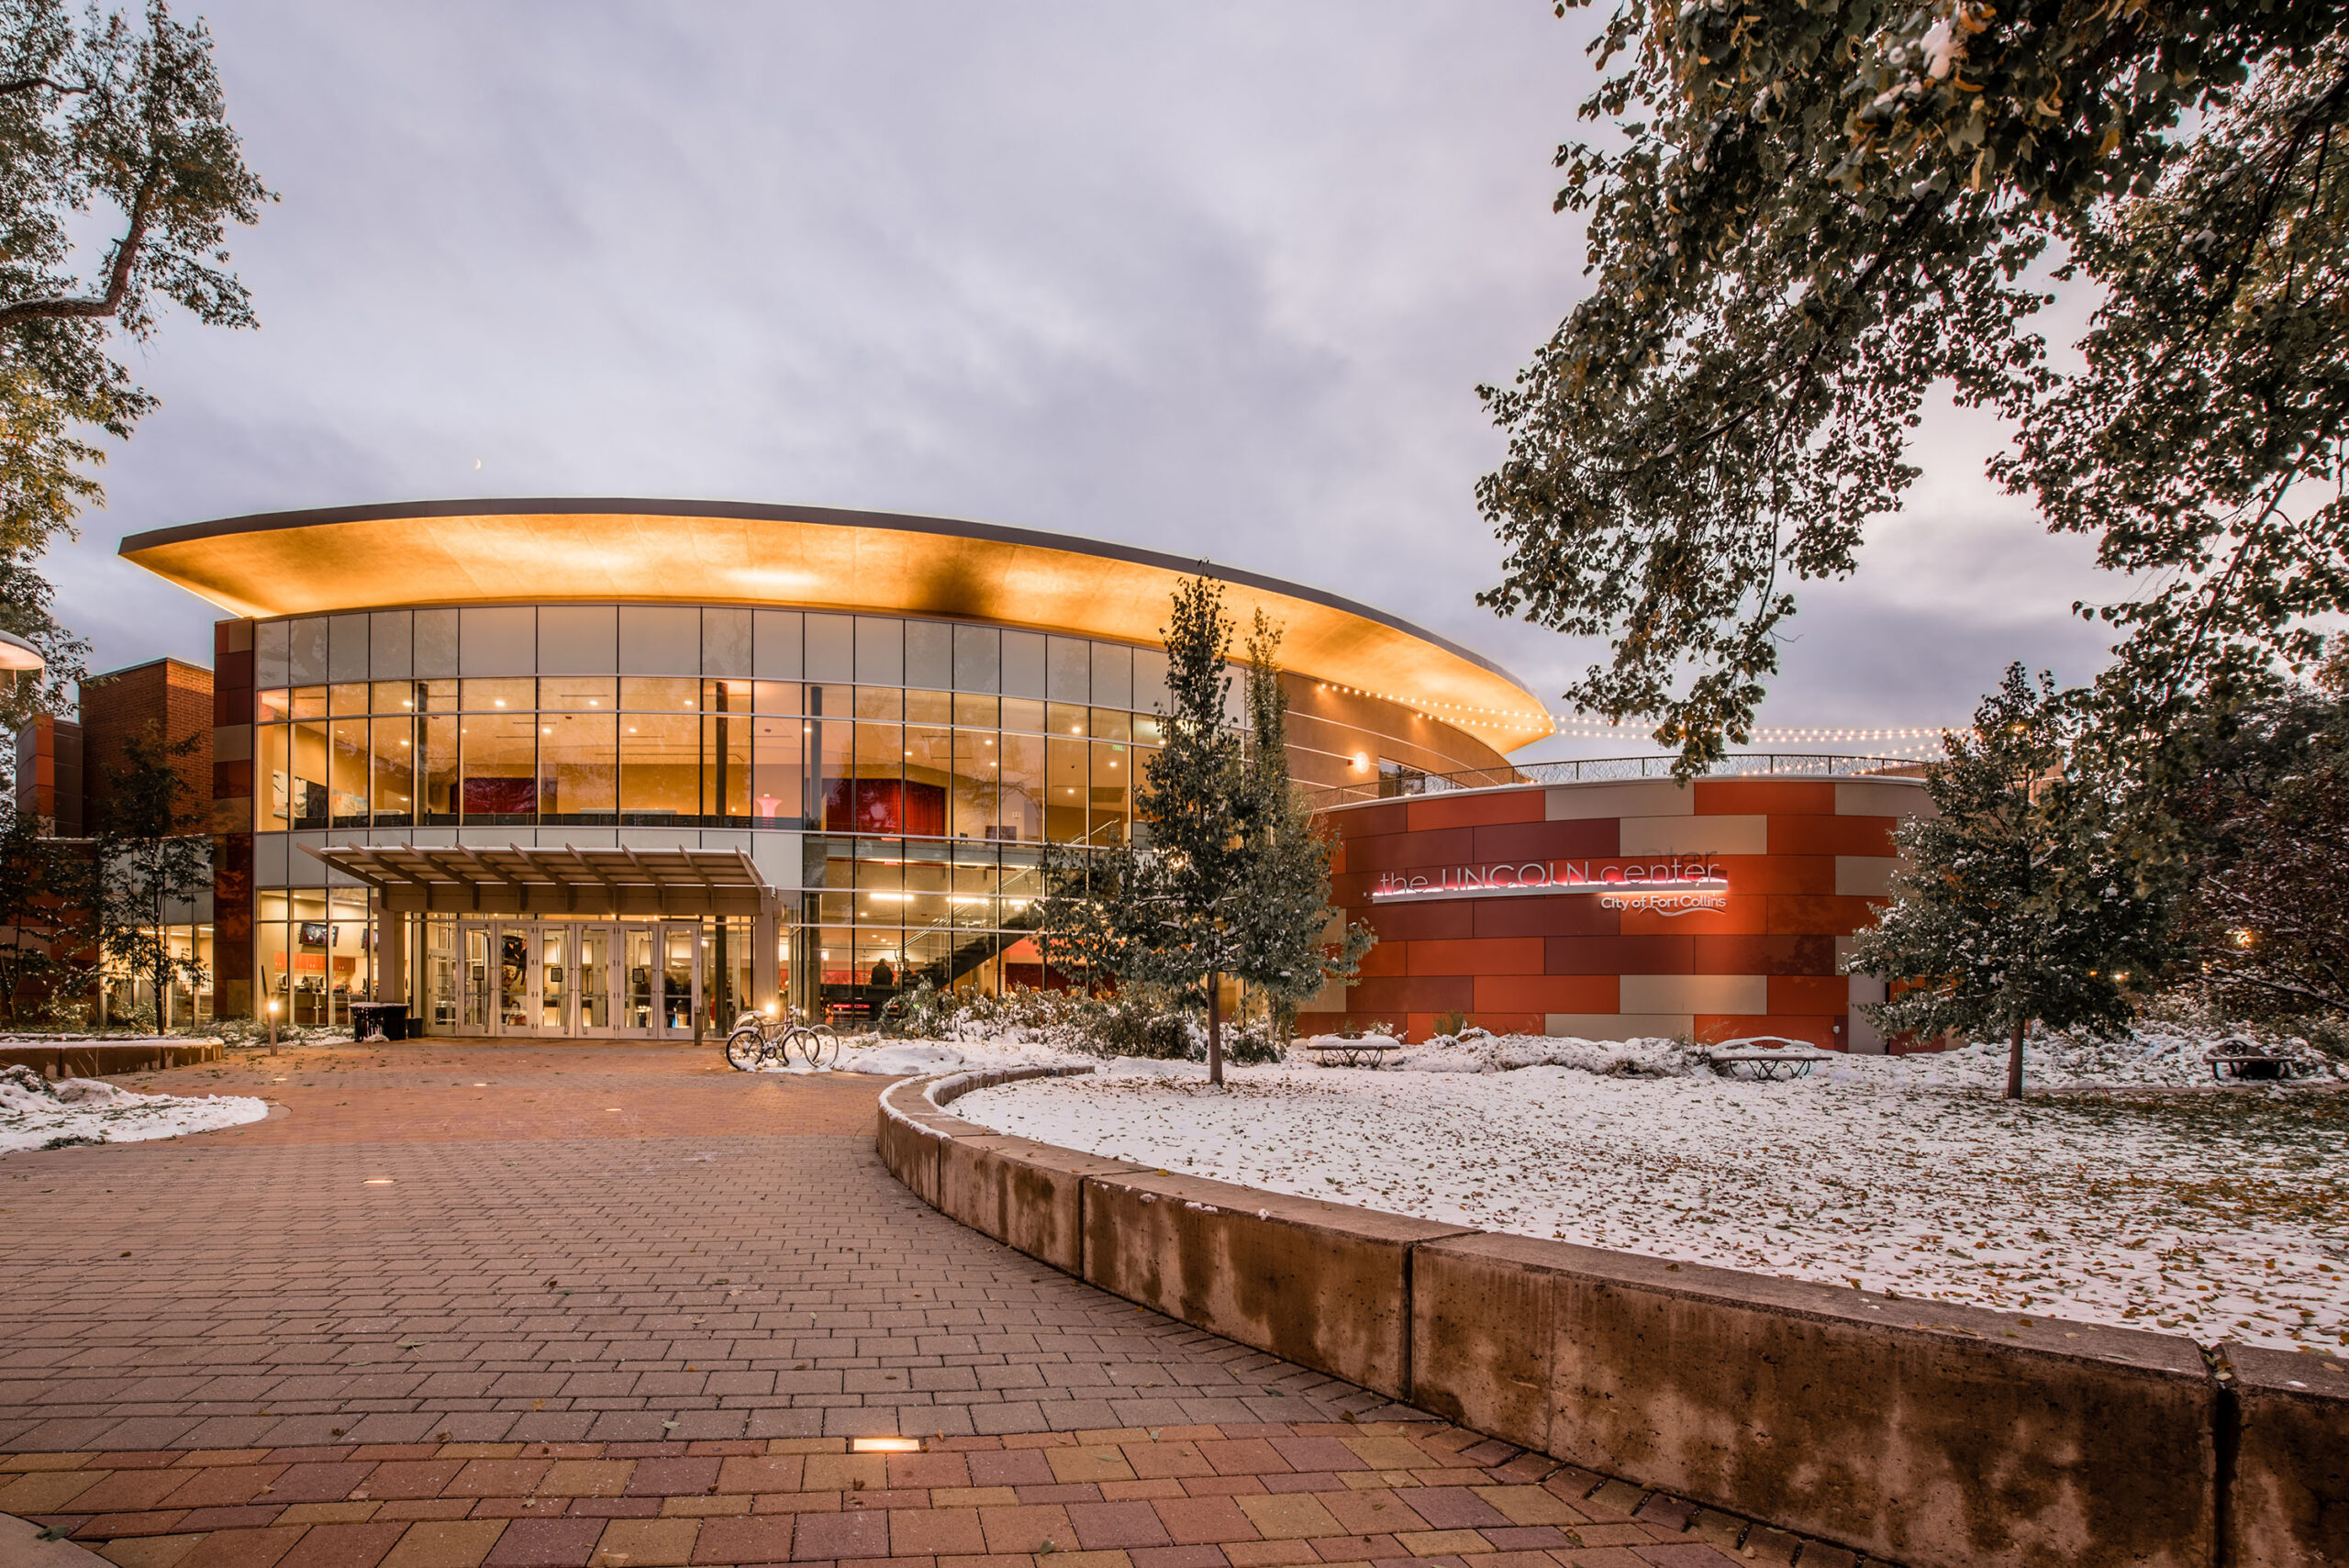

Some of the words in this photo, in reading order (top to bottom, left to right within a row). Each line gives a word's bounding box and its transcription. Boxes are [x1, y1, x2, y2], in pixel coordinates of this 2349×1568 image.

[1380, 873, 1429, 895] the
[1442, 862, 1589, 891] LINCOLN
[1600, 859, 1720, 885] center
[1601, 897, 1630, 911] City
[1631, 896, 1647, 907] of
[1651, 895, 1678, 908] Fort
[1680, 895, 1726, 907] Collins
